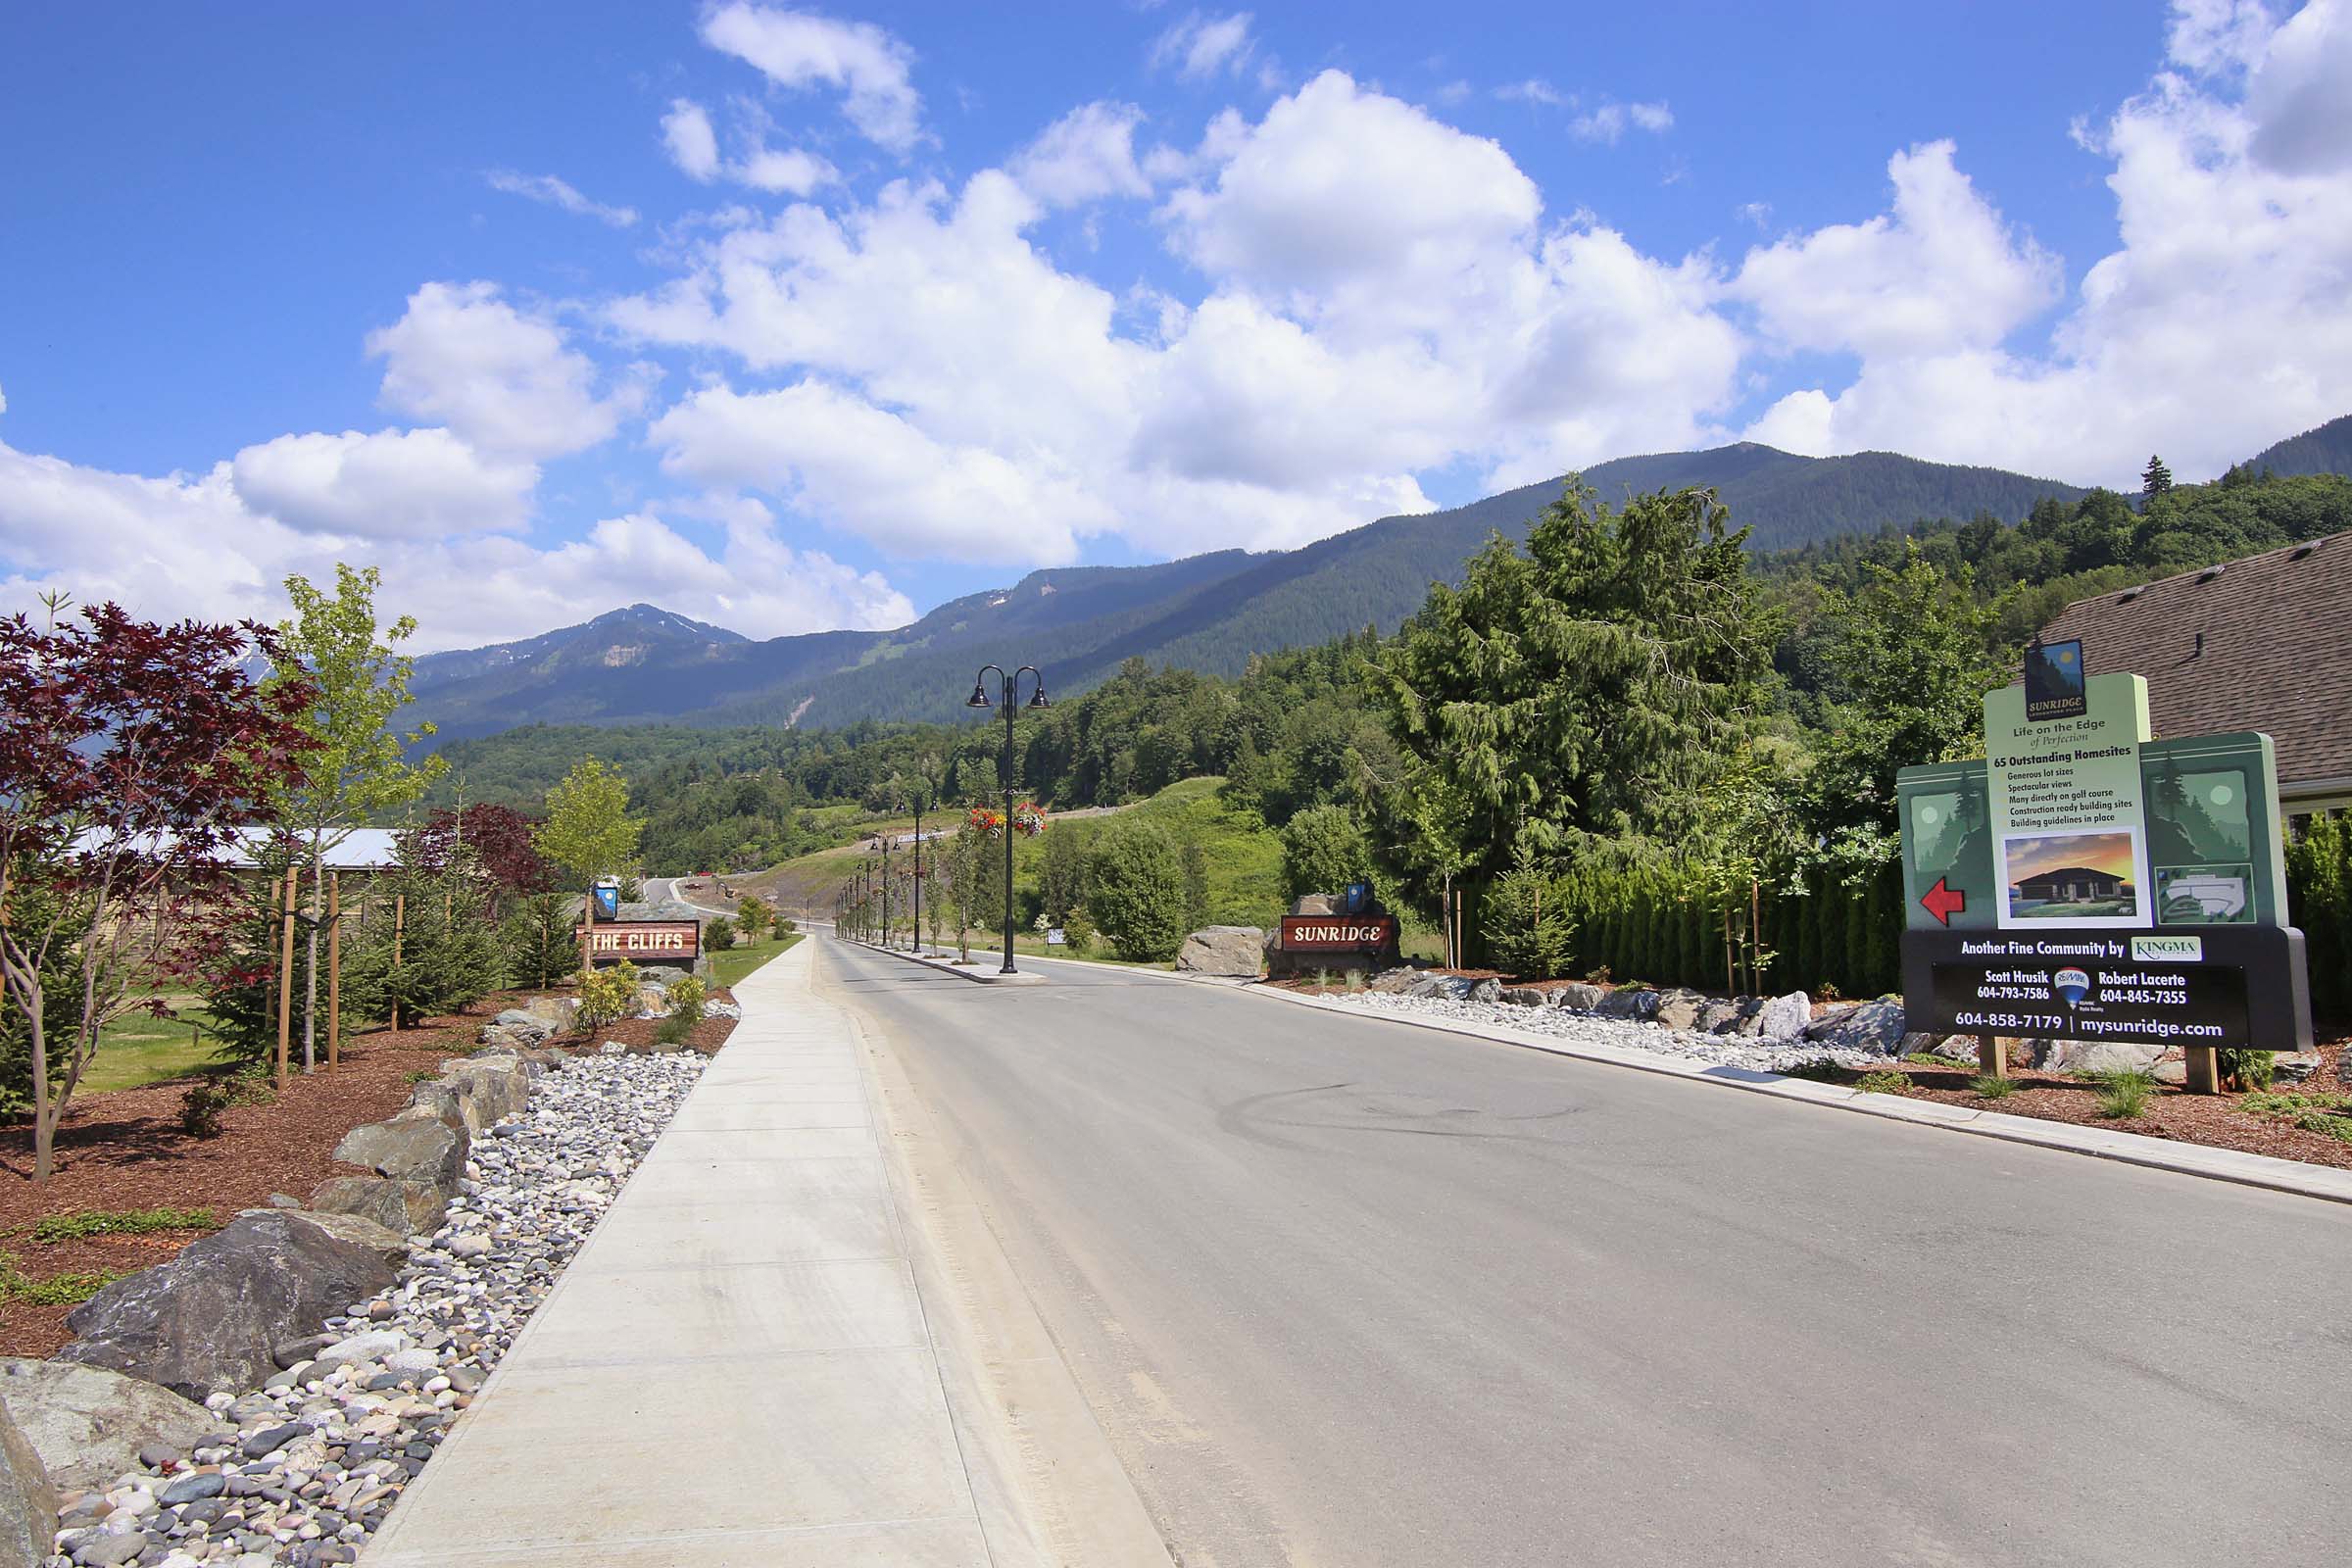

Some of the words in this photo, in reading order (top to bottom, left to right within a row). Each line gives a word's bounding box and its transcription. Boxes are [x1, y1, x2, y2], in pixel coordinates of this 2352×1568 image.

[2030, 697, 2082, 711] SUNRIDGE
[2013, 726, 2033, 737] Life
[2054, 723, 2072, 732] the
[2077, 719, 2106, 731] Edge
[2031, 738, 2041, 751] of
[2043, 733, 2088, 749] Perfection
[1993, 758, 2007, 768] 65
[2009, 751, 2072, 766] Outstanding
[2075, 746, 2132, 760] Homesites
[2007, 770, 2041, 780] Generous
[2043, 768, 2054, 777] lot
[2055, 767, 2074, 776] sizes
[2008, 781, 2049, 793] Spectacular
[2051, 780, 2073, 789] views
[2009, 795, 2030, 805] Many
[2031, 792, 2058, 803] directly
[2071, 789, 2086, 801] golf
[2088, 789, 2114, 798] course
[2010, 806, 2055, 815] Construction
[2056, 803, 2078, 813] ready
[2080, 800, 2113, 811] building
[2114, 799, 2132, 808] sites
[2011, 817, 2041, 828] Building
[2043, 814, 2082, 827] guidelines
[2083, 814, 2092, 823] in
[2094, 812, 2115, 824] place
[592, 933, 620, 951] THE
[627, 933, 683, 951] CLIFFS
[1295, 926, 1381, 942] SUNRIDGE
[1961, 941, 2006, 955] Another
[2009, 941, 2034, 955] Fine
[2036, 941, 2105, 957] Community
[2109, 941, 2125, 957] by
[2136, 941, 2196, 959] KINGMA
[1984, 970, 2011, 983] Scott
[2013, 970, 2049, 984] Hrusik
[2098, 971, 2137, 985] Robert
[2140, 972, 2185, 986] Lacerte
[1977, 986, 2050, 1000] 604-793-7586
[2099, 990, 2186, 1004] 604-845-7355
[1955, 1012, 2062, 1029] 604-858-7179
[2081, 1018, 2223, 1037] mysunridge.com
